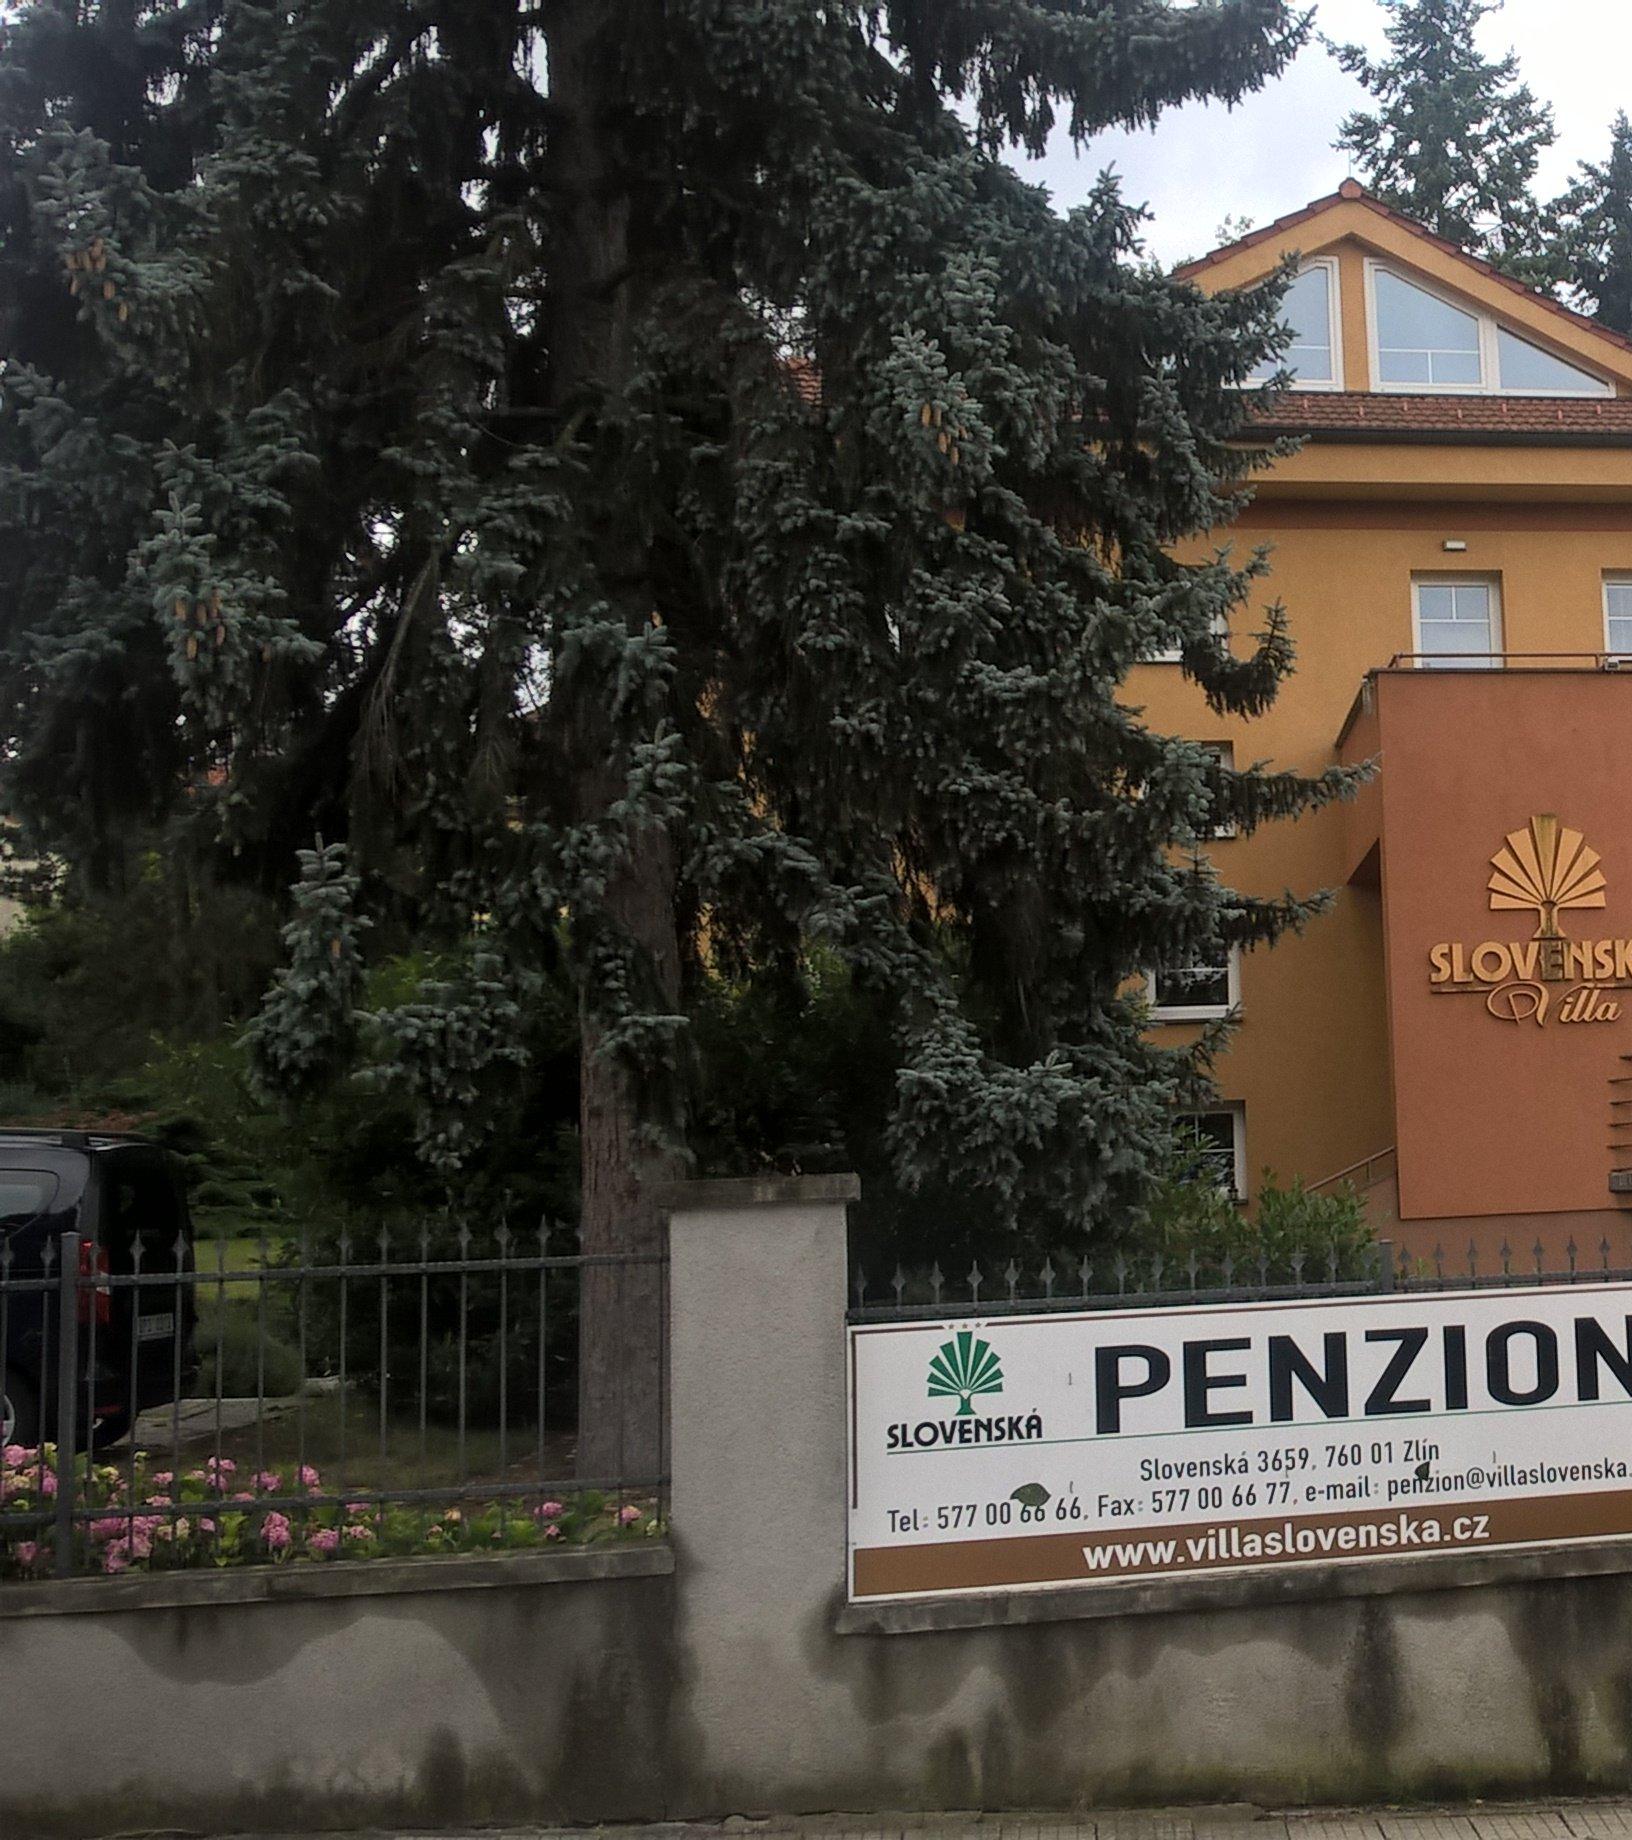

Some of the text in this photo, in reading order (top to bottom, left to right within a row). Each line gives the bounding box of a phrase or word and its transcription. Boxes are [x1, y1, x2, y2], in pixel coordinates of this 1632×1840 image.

[1486, 983, 1622, 1028] Villa
[886, 1408, 1043, 1449] SLOVENSKÁ
[1140, 1439, 1440, 1481] Slovenská 3659, 760 01 Zlín
[887, 1508, 929, 1532] Tel:
[937, 1504, 977, 1529] 577
[985, 1502, 1011, 1525] 00
[1055, 1497, 1089, 1520] 66,
[1098, 1494, 1144, 1517] Fax:
[1152, 1489, 1190, 1513] 577
[1198, 1486, 1222, 1510] 00
[1232, 1483, 1257, 1507] 66
[1266, 1481, 1298, 1505] 77,
[1305, 1475, 1379, 1501] e-mail:
[1082, 1513, 1491, 1571] www.villaslovenska.cz
